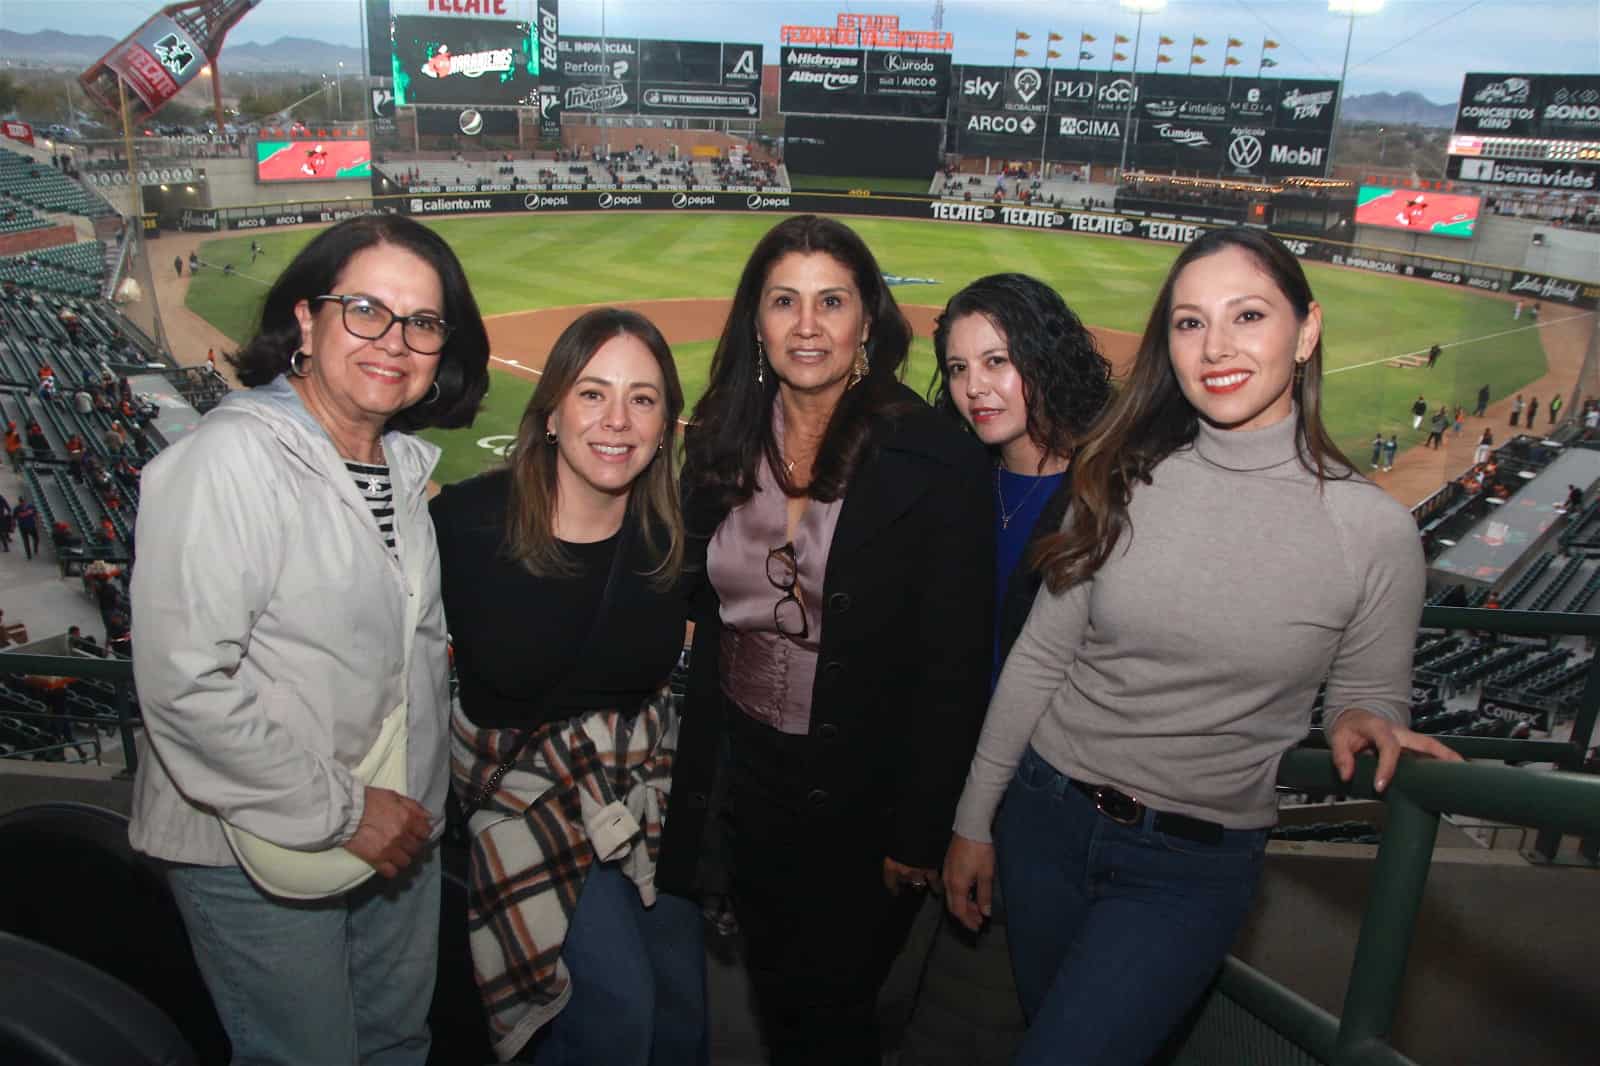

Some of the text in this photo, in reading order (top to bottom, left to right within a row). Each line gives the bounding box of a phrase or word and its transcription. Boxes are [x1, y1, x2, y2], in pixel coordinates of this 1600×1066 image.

[540, 8, 558, 71] telcel
[558, 41, 573, 52] EL
[564, 61, 610, 73] Perform
[797, 53, 858, 69] Hidrogas
[788, 71, 859, 89] Albatros
[964, 76, 1000, 100] sky
[1098, 84, 1138, 103] facl
[1462, 107, 1536, 120] CONCRETOS
[1544, 104, 1600, 120] SONO
[967, 116, 1018, 133] ARCO
[1076, 119, 1121, 137] CIMA
[1478, 118, 1512, 129] KINO
[1270, 145, 1322, 166] Mobil
[1493, 167, 1594, 188] benavides
[424, 198, 491, 211] caliente.mx
[541, 195, 568, 207] pepsi
[614, 195, 642, 207] pepsi
[688, 195, 715, 207] pepsi
[762, 196, 790, 208] pepsi
[930, 202, 985, 222] TECATE
[1000, 206, 1055, 228] TECATE
[1069, 213, 1124, 234] TECATE
[1483, 703, 1542, 725] Comex
